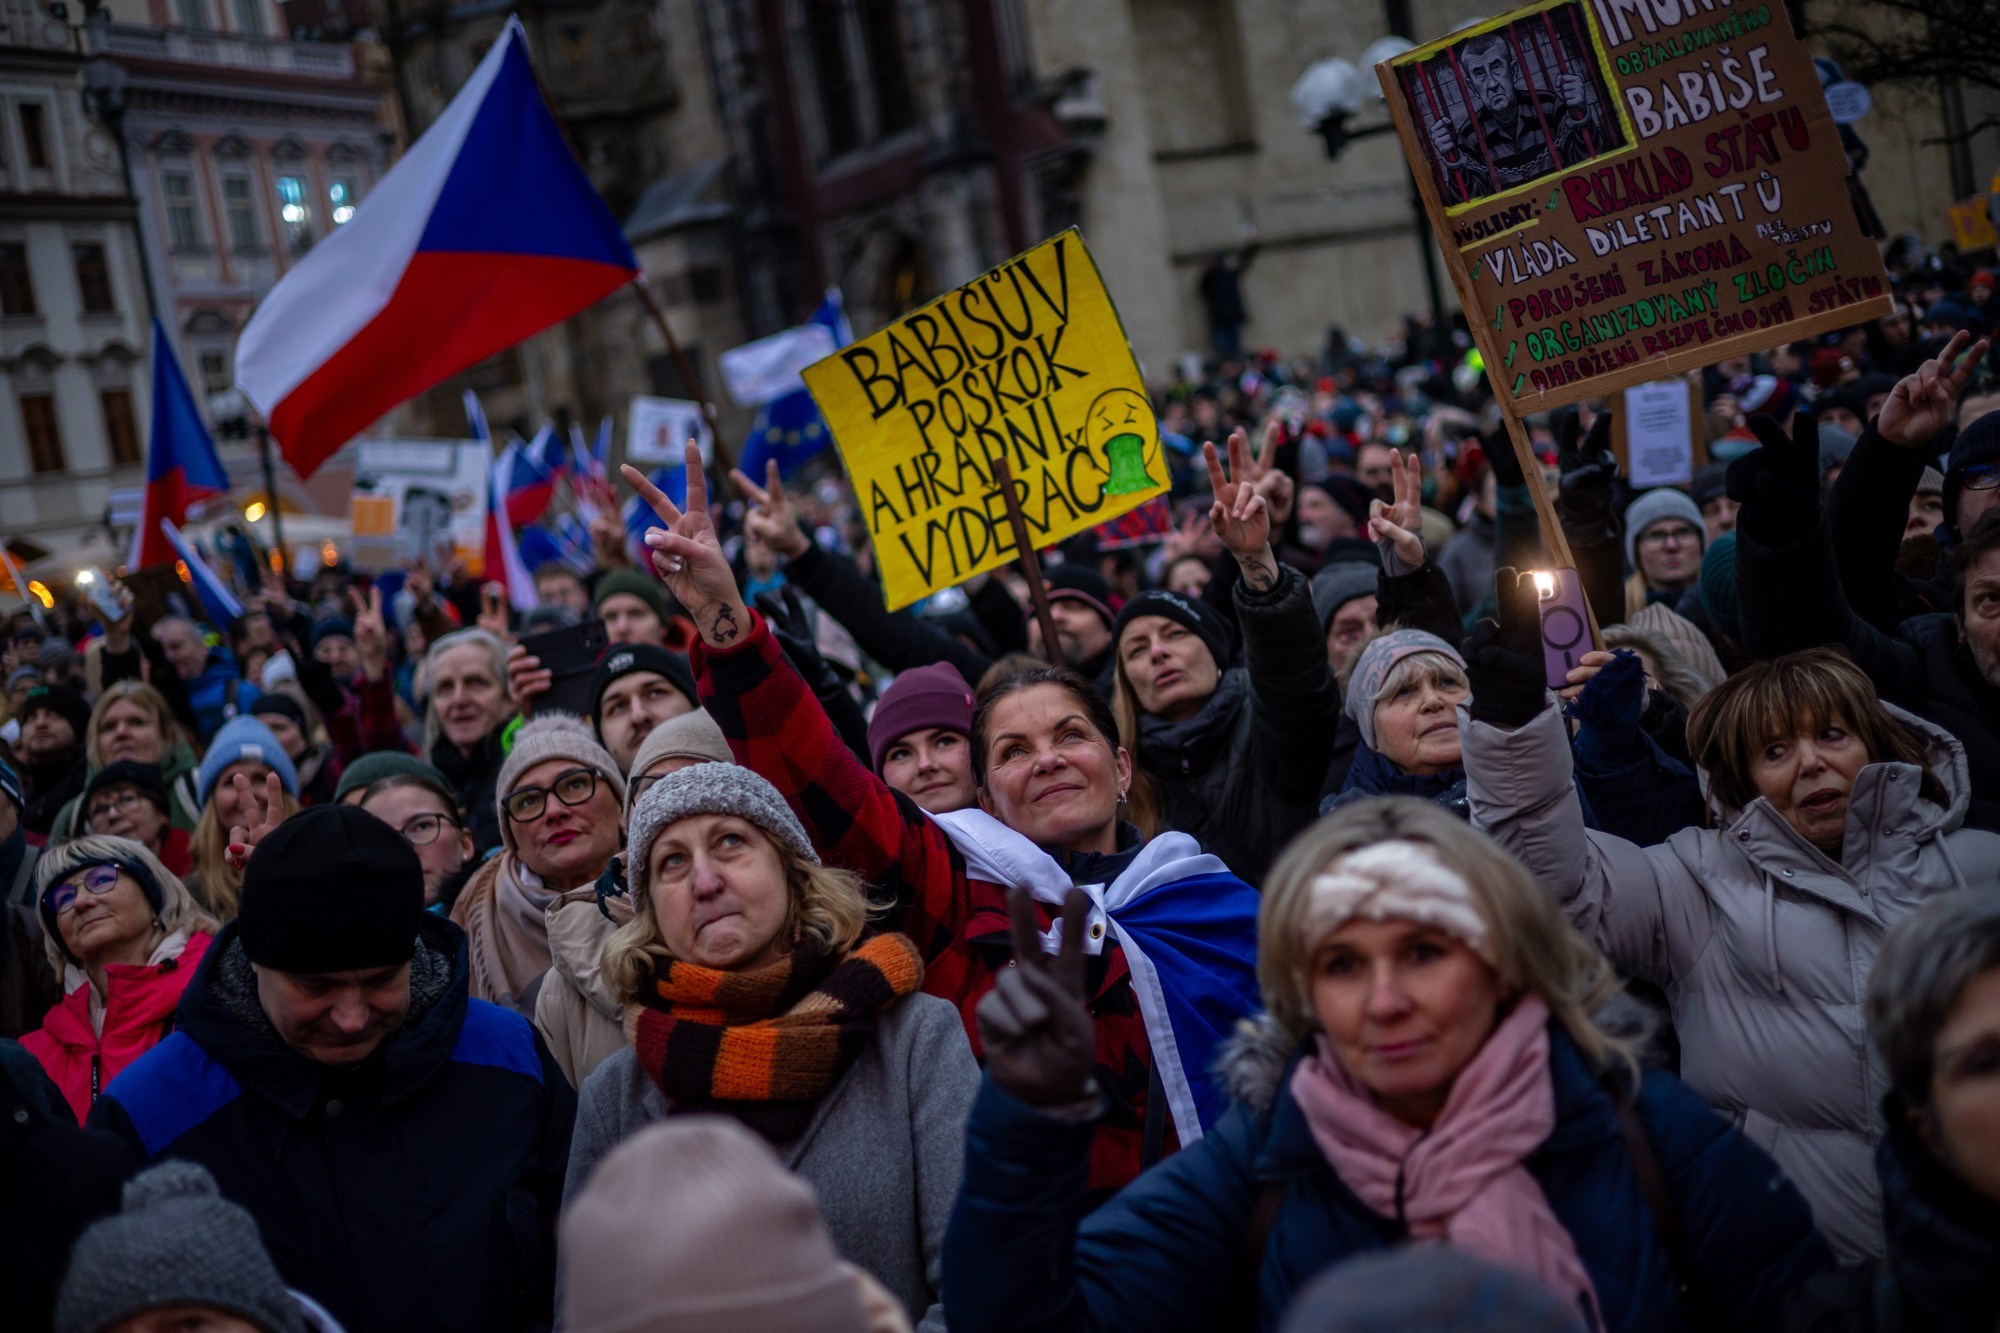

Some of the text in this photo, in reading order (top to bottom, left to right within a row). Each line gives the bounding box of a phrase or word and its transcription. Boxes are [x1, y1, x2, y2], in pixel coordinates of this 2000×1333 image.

[1561, 106, 1810, 224] ROZKLAD STÁTU
[1756, 219, 1787, 239] BEZ
[1772, 218, 1833, 246] TRESTU
[1483, 231, 1579, 287] VLÁDA
[1637, 233, 1752, 287] ZÁKONA
[1732, 245, 1838, 303] ZLOČIN
[1808, 274, 1882, 315] STÁTU
[842, 238, 1070, 420] BABIŠŮV
[907, 322, 1090, 451] POSKOK
[871, 375, 1068, 535] A HRADNÍ
